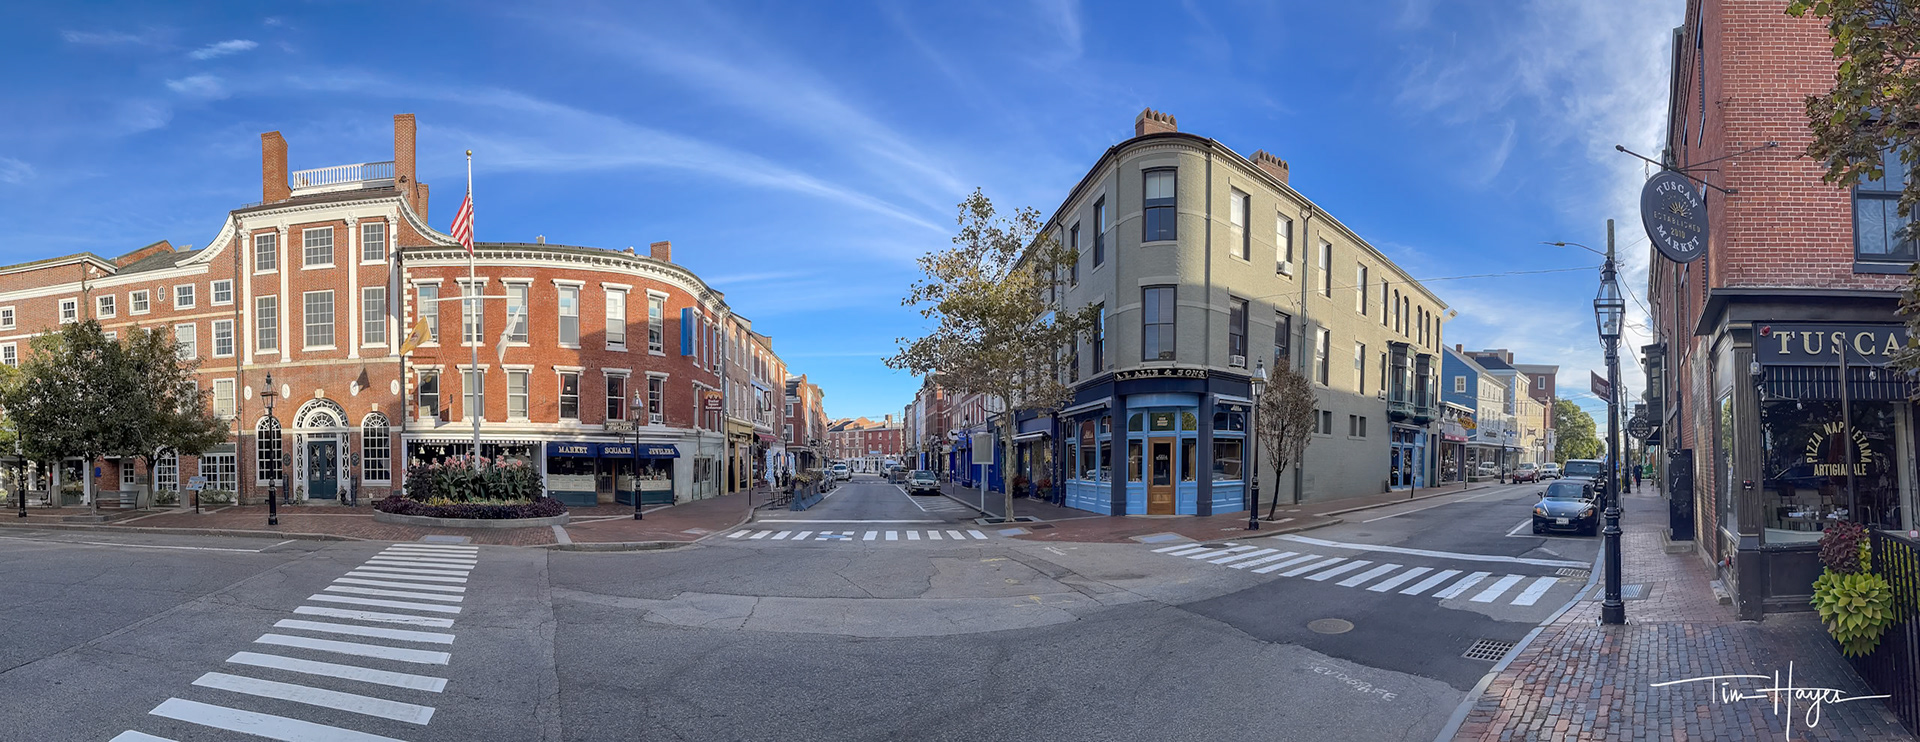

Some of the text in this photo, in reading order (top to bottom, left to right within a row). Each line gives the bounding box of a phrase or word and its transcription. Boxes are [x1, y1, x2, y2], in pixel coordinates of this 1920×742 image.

[1656, 181, 1698, 208] TUSCAN
[1656, 224, 1699, 252] MARKET
[1773, 331, 1901, 356] TUSCA
[558, 446, 675, 455] MARKET SQUARE JEWELERS
[1805, 421, 1872, 463] PIZZA NAPETANA
[1813, 463, 1867, 476] ARTIGIAALE
